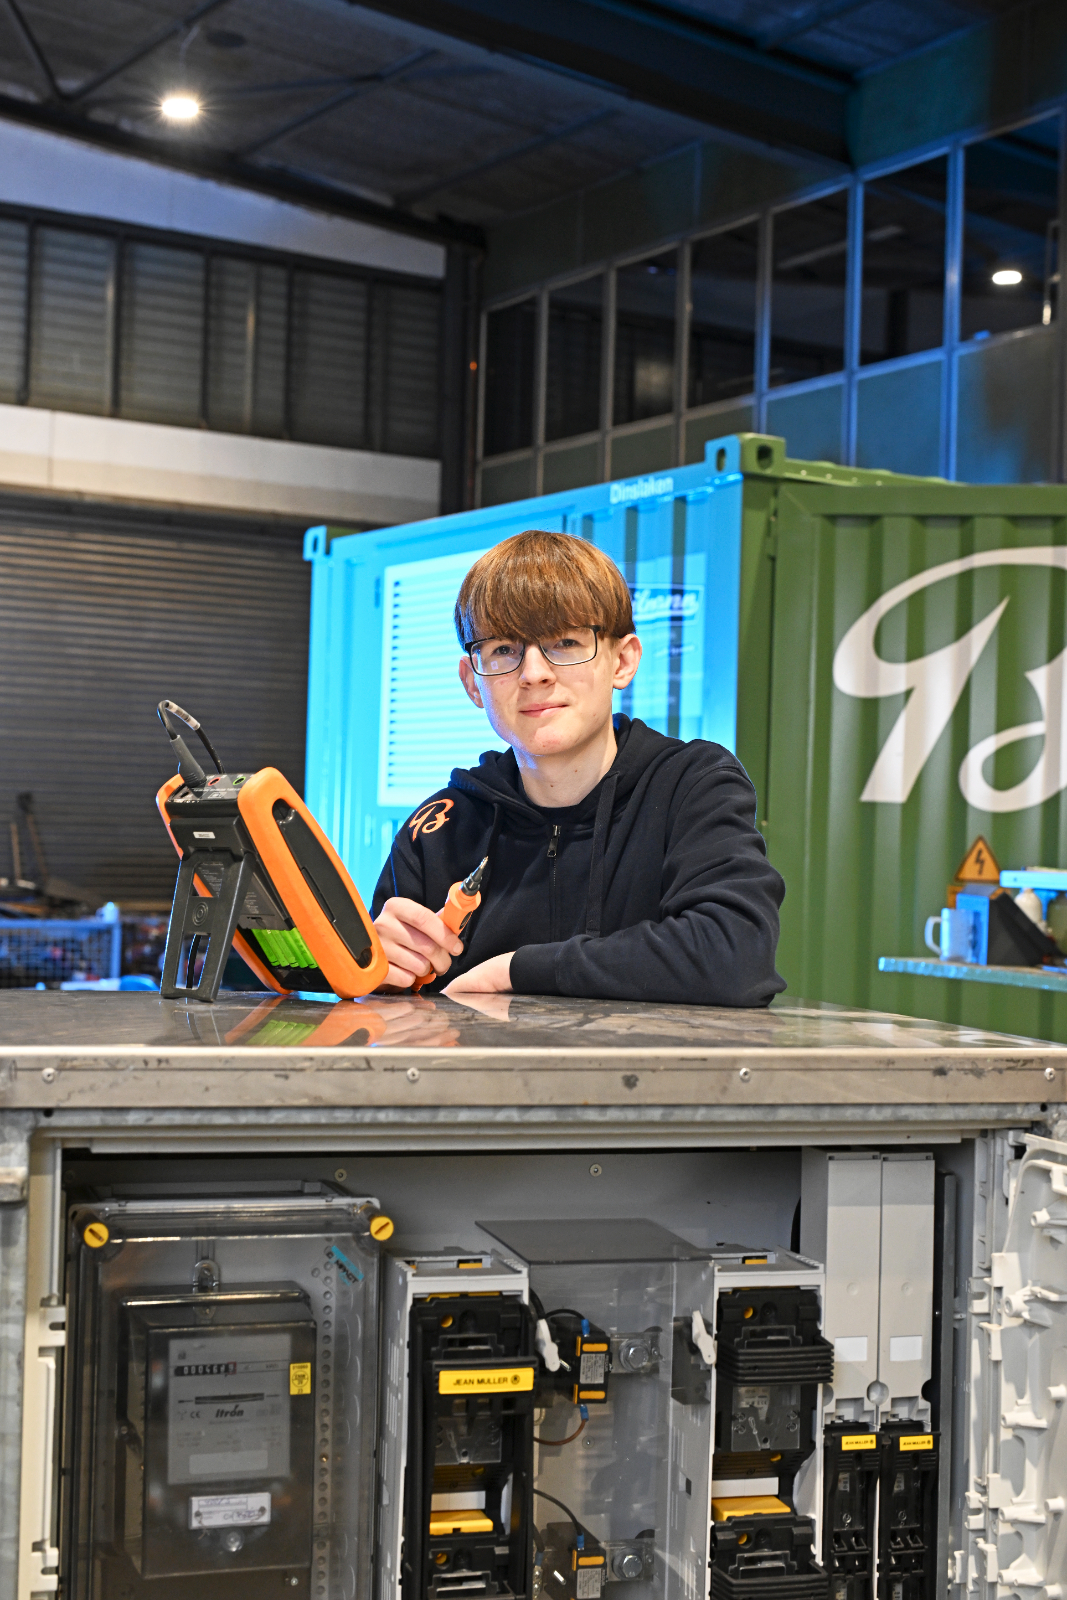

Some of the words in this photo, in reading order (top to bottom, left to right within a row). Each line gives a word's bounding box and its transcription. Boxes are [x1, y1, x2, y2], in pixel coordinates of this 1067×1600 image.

[610, 475, 673, 504] Dinslaken
[453, 1378, 475, 1386] JEAN
[215, 1405, 244, 1418] Itron
